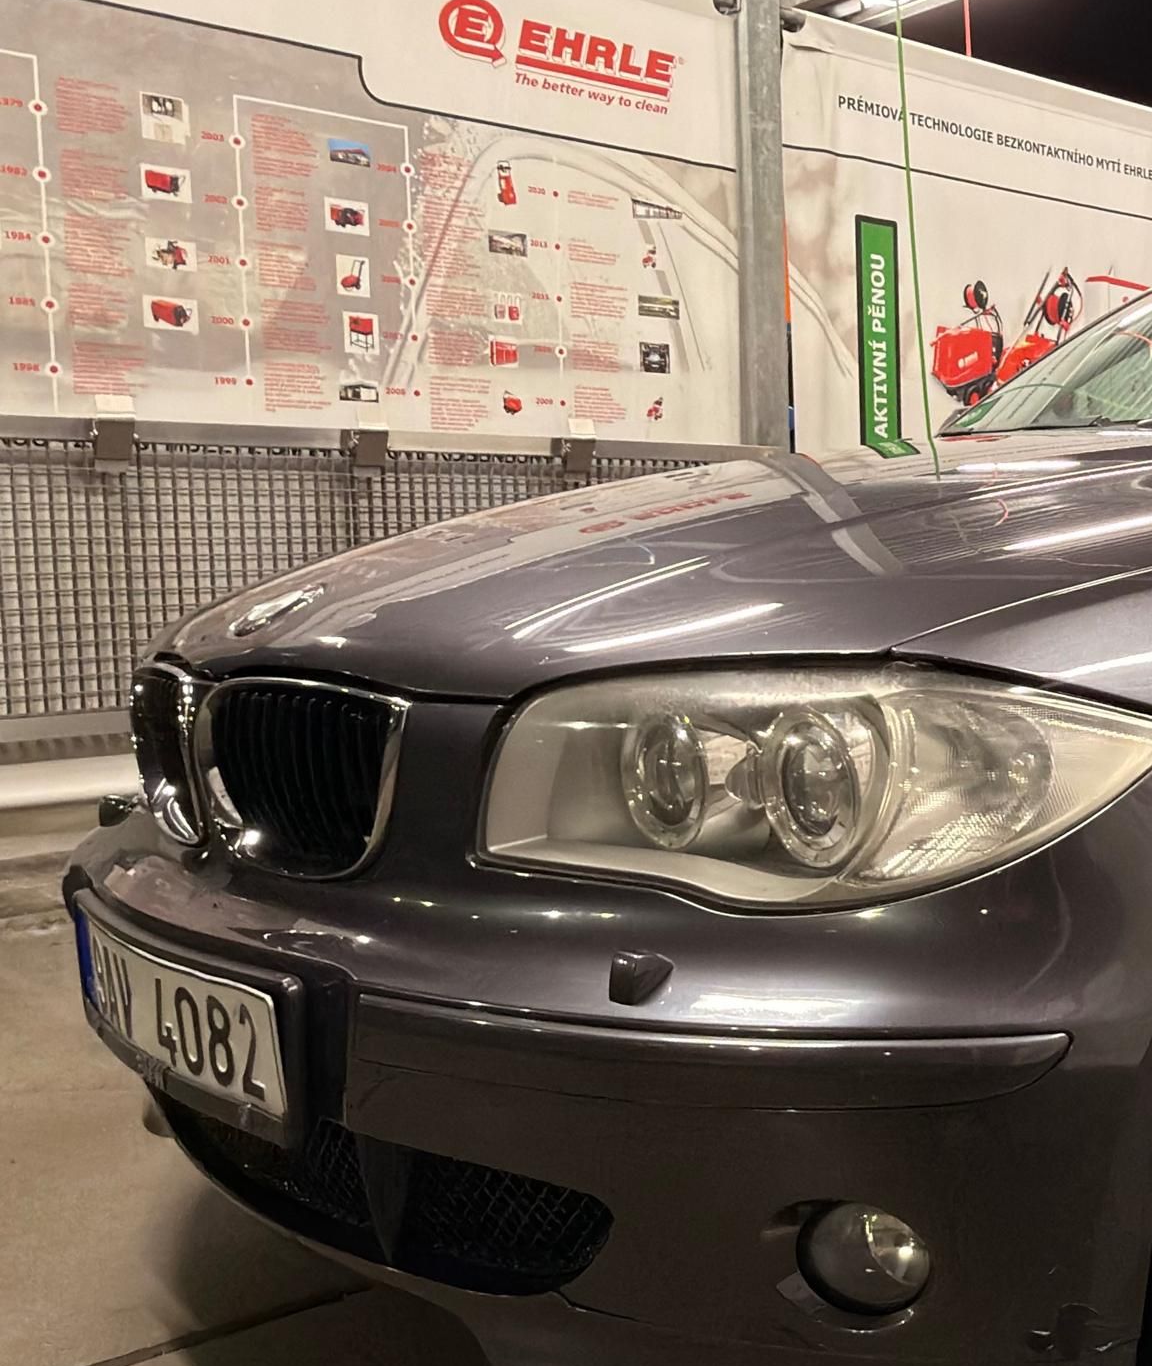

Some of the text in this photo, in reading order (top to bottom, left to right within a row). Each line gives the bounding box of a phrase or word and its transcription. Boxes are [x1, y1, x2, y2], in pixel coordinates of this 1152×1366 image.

[518, 19, 676, 84] EHRLE
[514, 72, 669, 115] The better way to clean
[909, 112, 994, 144] TECHNOLOGIE
[996, 133, 1094, 168] BEZKONTAKTNÍHO
[1095, 156, 1122, 175] MYTÍ
[867, 253, 889, 439] AKTIVNÍ PĚNOU
[155, 977, 266, 1103] 4082
